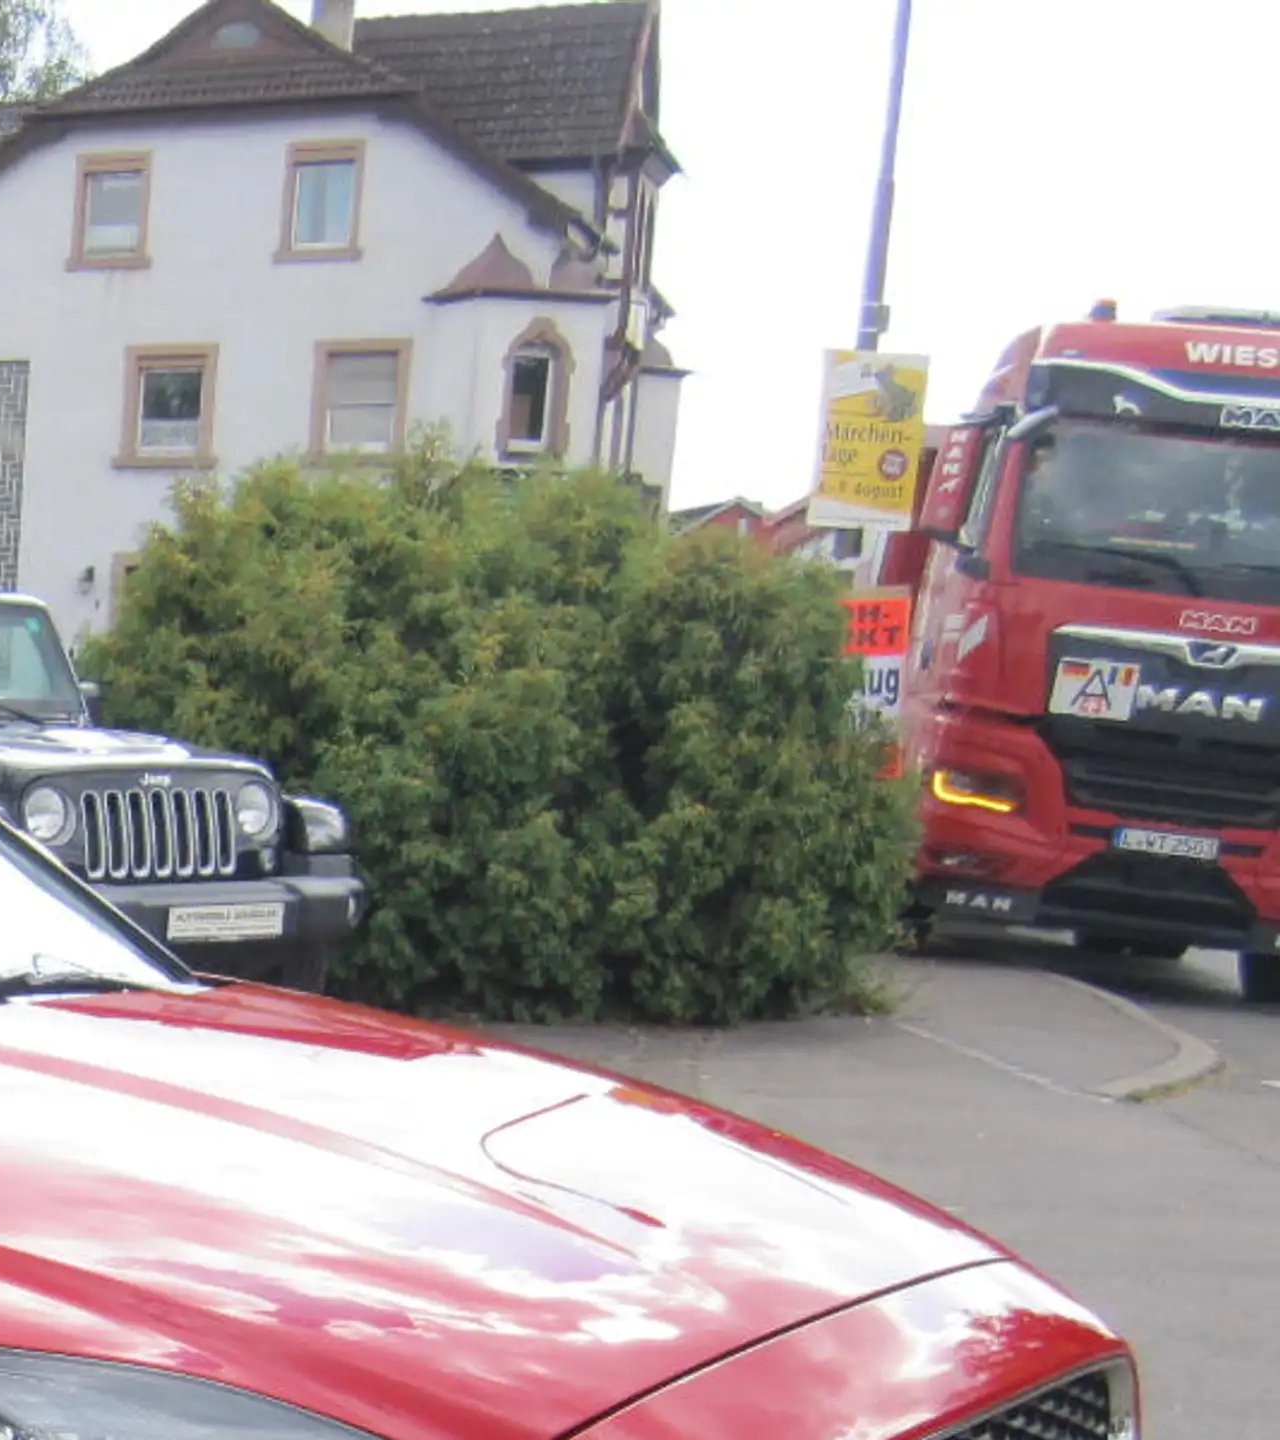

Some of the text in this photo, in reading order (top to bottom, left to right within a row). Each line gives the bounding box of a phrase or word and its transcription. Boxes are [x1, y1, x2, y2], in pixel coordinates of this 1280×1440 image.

[1178, 609, 1258, 635] MAN
[861, 667, 900, 706] ug
[1069, 667, 1112, 711] A
[1136, 683, 1267, 722] MAN
[945, 889, 1013, 912] MAN
